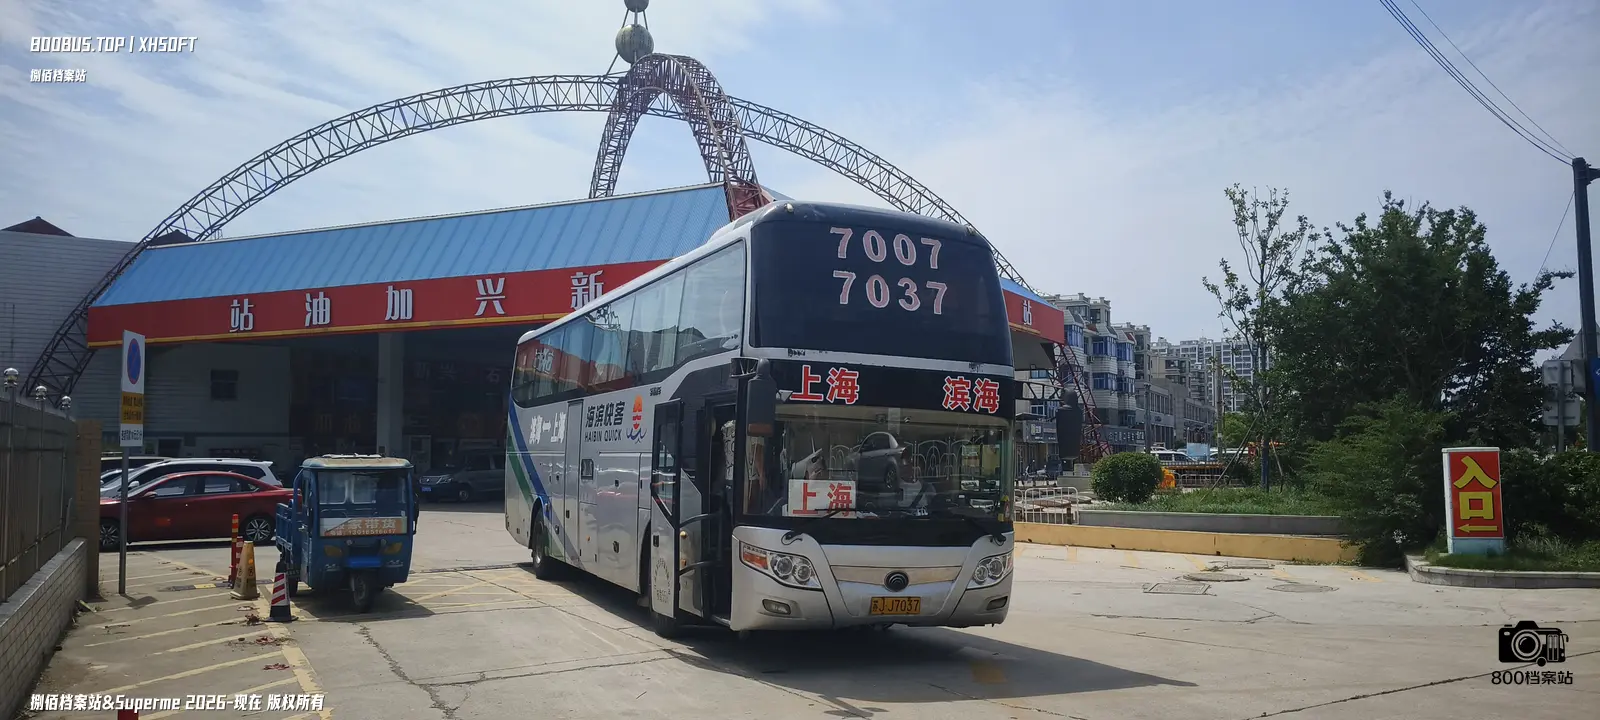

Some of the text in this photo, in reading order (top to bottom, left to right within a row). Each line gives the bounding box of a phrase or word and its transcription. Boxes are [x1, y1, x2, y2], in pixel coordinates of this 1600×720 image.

[829, 226, 943, 270] 7007
[832, 270, 948, 315] 7037
[790, 364, 1001, 414] 上海 滨海
[604, 429, 623, 442] QUICK
[792, 483, 853, 517] 上海
[1453, 455, 1498, 521] 入口
